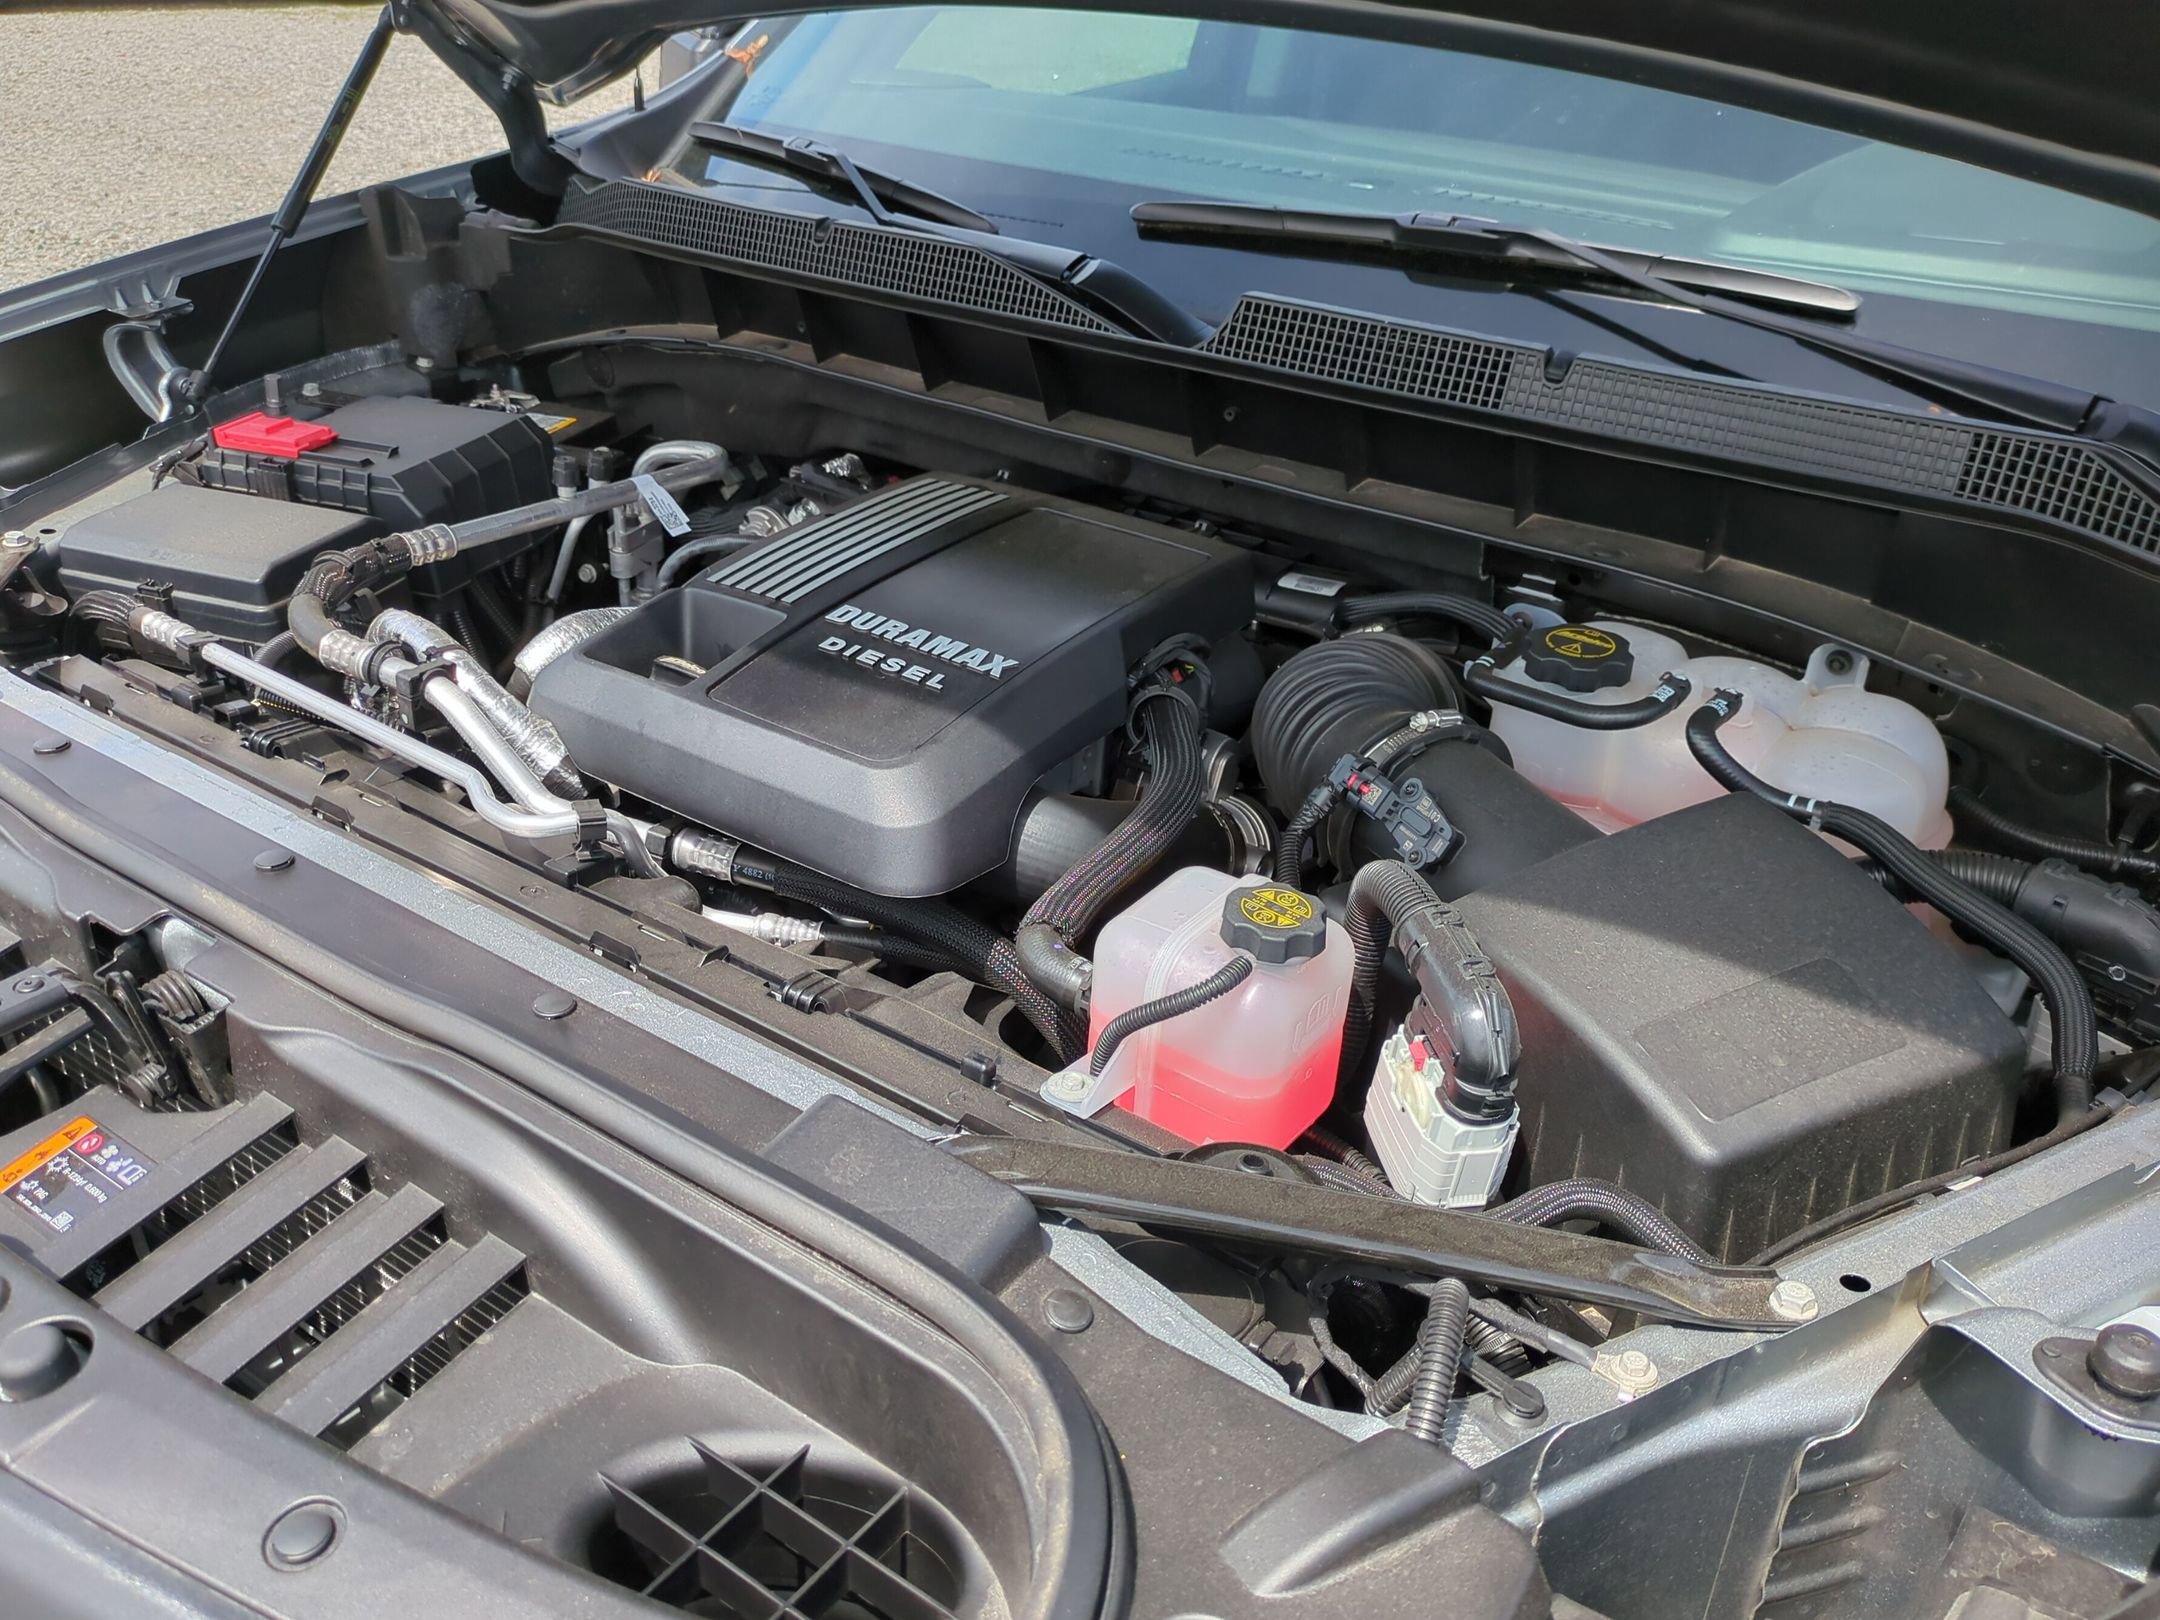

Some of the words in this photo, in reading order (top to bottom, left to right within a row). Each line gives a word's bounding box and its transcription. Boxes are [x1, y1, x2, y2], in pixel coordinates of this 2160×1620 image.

[818, 636, 946, 692] DIESEL
[825, 604, 1020, 680] DURAMAX
[742, 867, 763, 879] 4882
